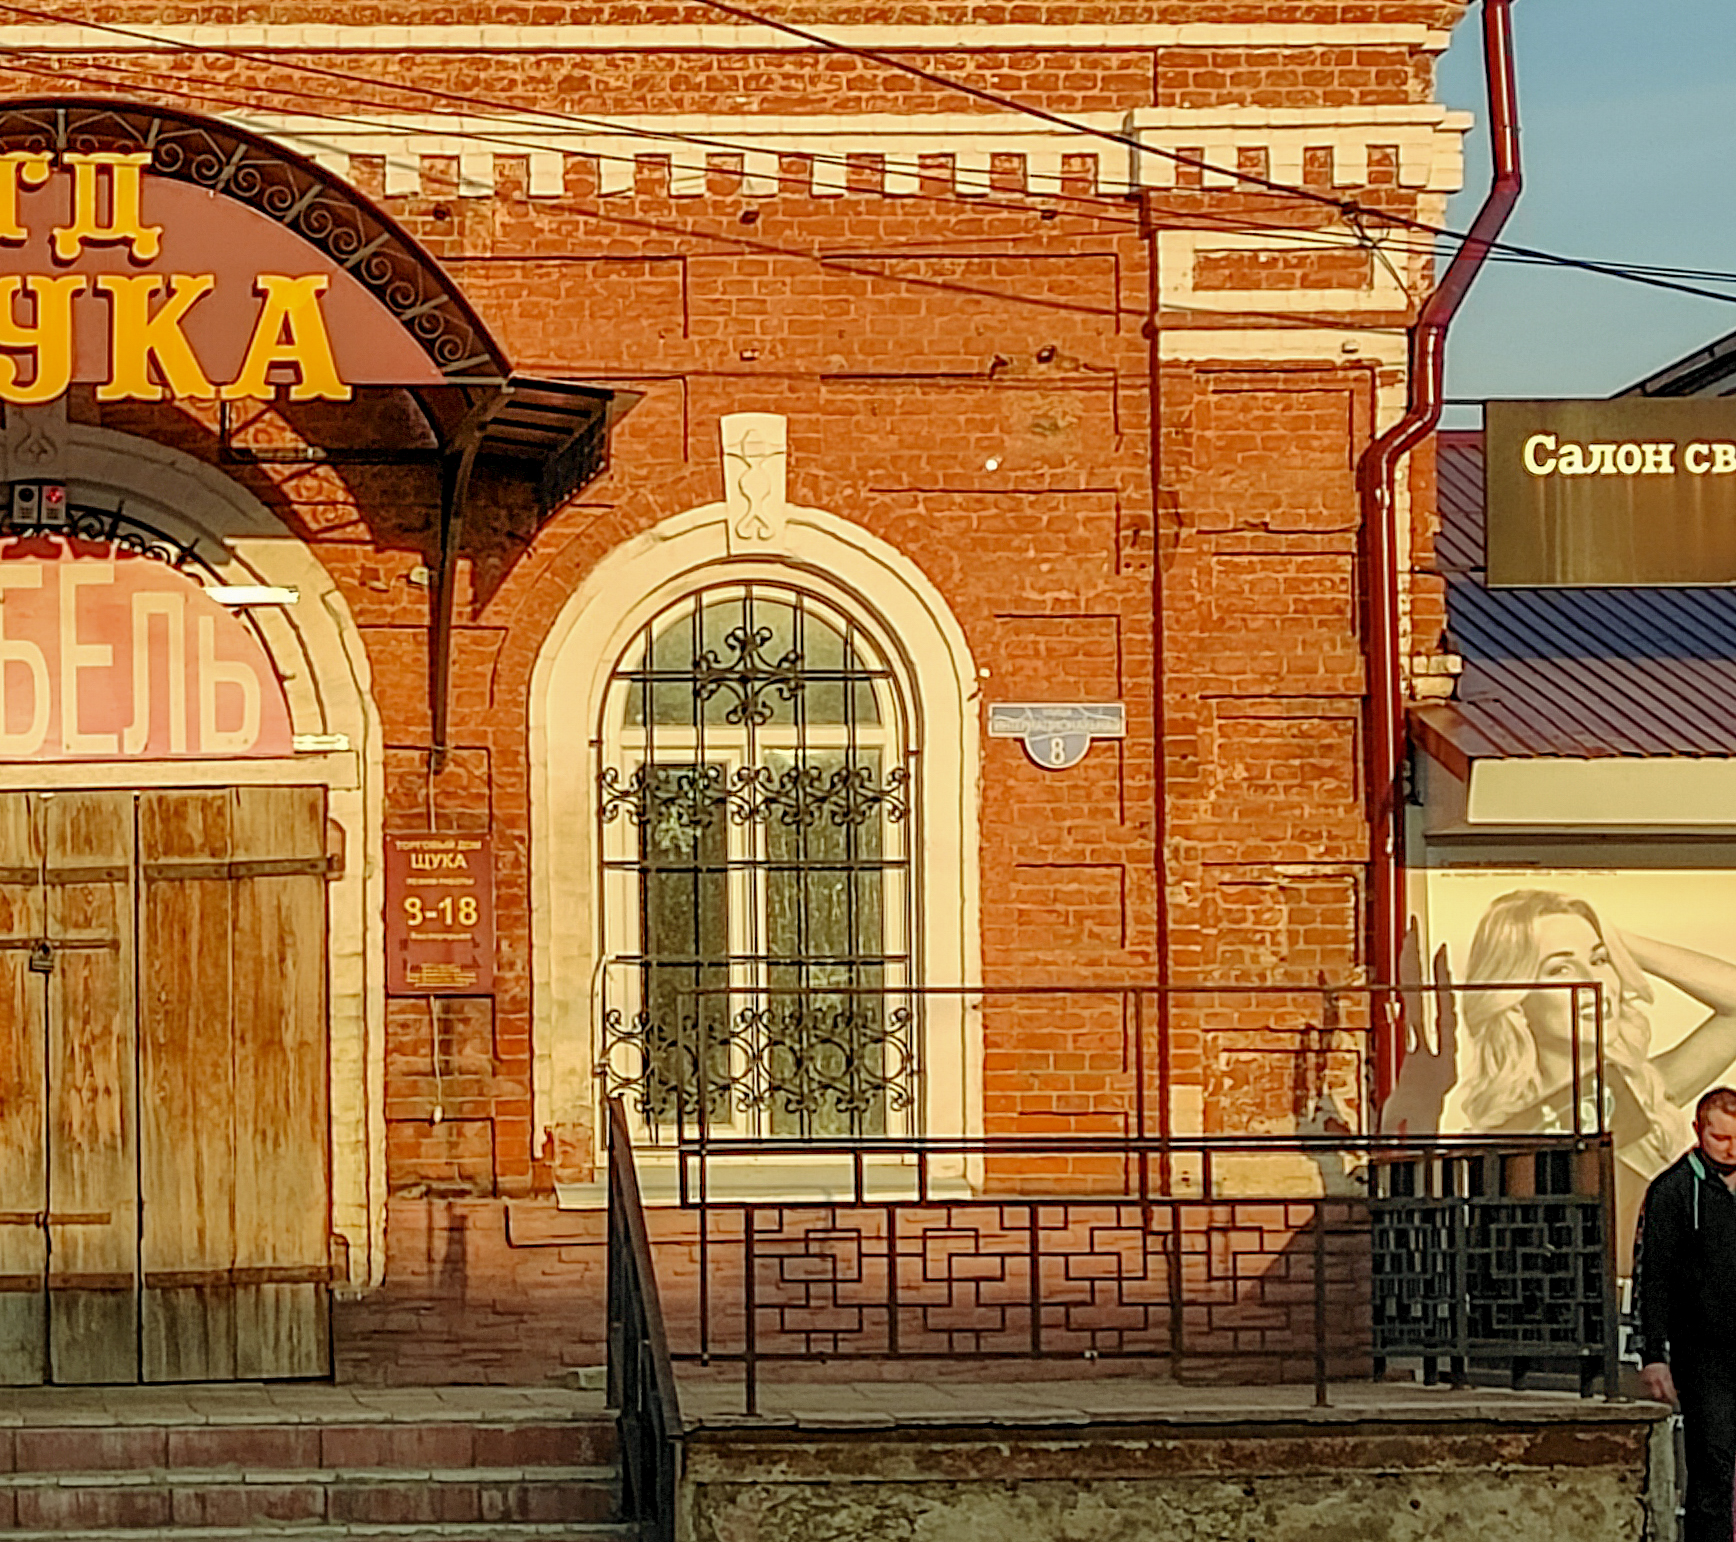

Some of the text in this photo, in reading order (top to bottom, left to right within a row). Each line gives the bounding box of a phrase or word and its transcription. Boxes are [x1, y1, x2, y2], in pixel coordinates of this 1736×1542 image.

[1523, 433, 1736, 475] Салон св
[1051, 737, 1065, 765] 8
[410, 853, 468, 870] ЩУКА
[403, 896, 479, 927] 9-18
